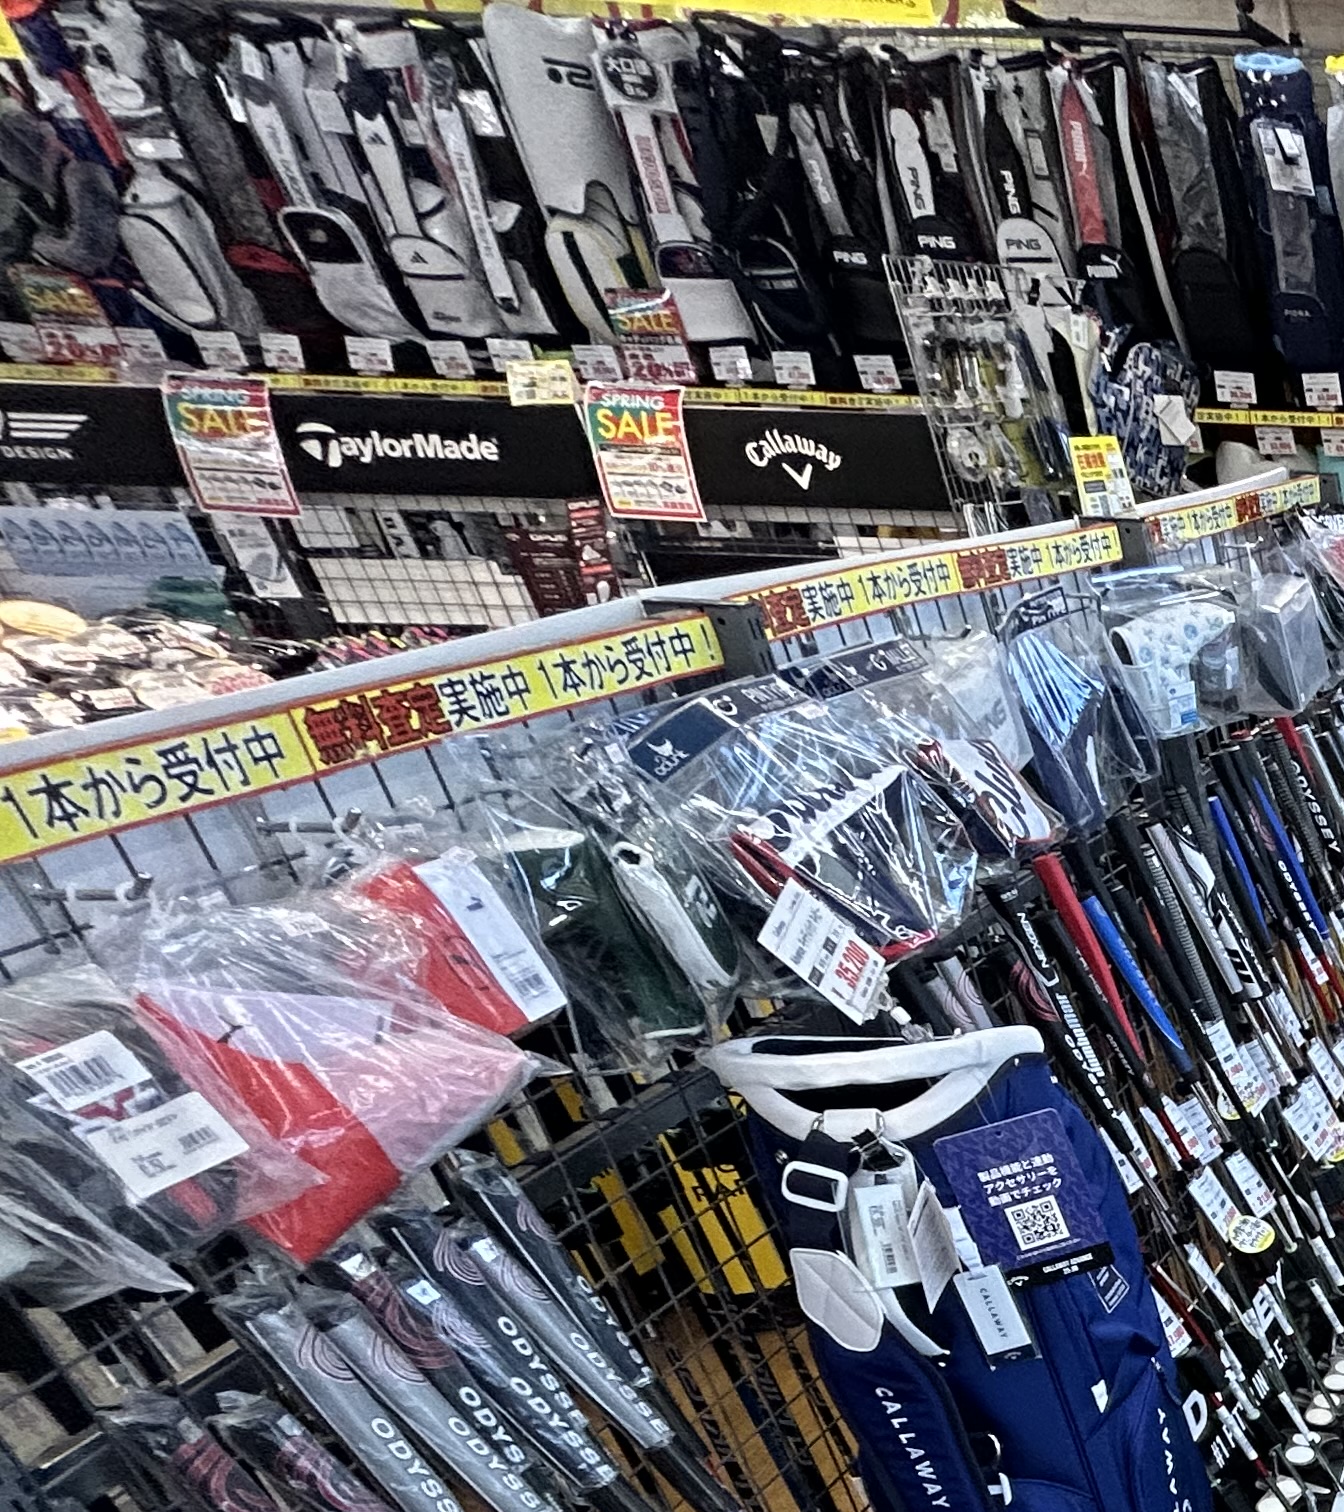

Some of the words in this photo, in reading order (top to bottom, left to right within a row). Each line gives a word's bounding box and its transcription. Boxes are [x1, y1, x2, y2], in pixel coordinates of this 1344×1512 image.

[906, 166, 926, 211] PING
[1001, 170, 1021, 215] PING
[832, 250, 868, 265] PING
[918, 235, 956, 250] PING
[1006, 238, 1042, 251] PING
[177, 402, 270, 437] SALE
[600, 393, 665, 410] SPRING
[297, 421, 500, 466] TaylorMade
[596, 409, 677, 444] SALE
[744, 428, 843, 473] Callaway
[4, 725, 285, 839] 1本から受付中
[979, 1287, 1009, 1339] CALLAWAY
[874, 1385, 951, 1510] CALLAWAY
